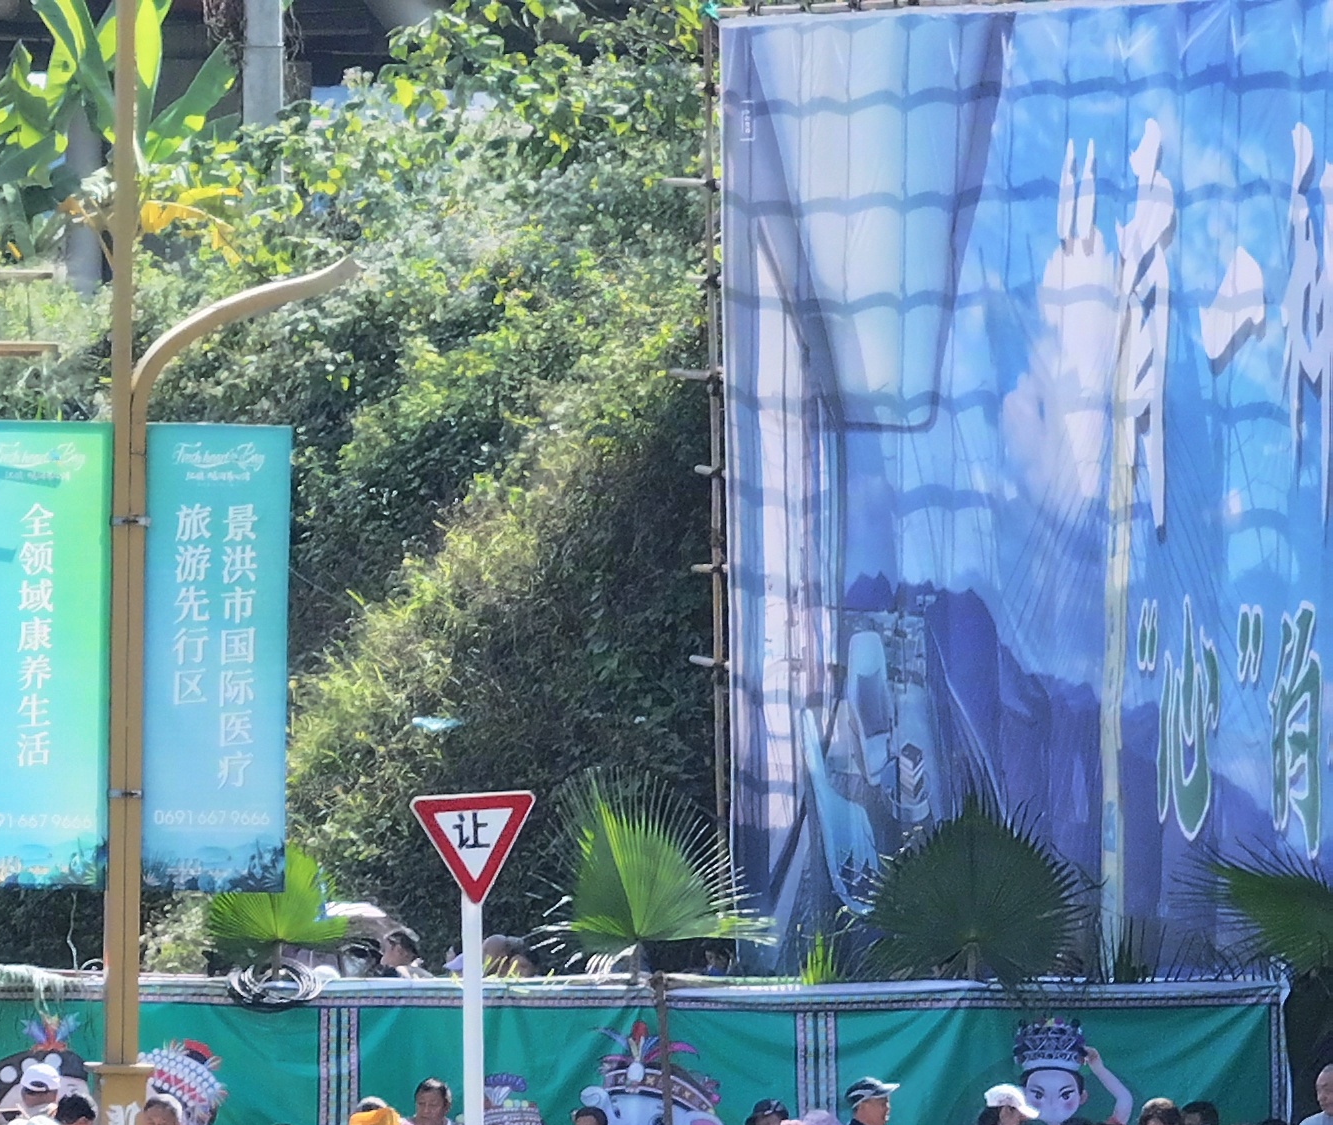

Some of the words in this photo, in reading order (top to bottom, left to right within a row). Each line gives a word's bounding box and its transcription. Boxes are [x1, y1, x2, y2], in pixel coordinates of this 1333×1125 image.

[18, 503, 54, 767] 全领域康养生活
[173, 503, 212, 706] 旅游先行区
[218, 503, 258, 789] 景洪市国际医疗
[17, 812, 48, 829] 667
[51, 812, 93, 829] 9666
[153, 810, 194, 826] 0691
[197, 810, 227, 826] 667
[230, 810, 271, 826] 9666
[452, 812, 490, 850] 让
